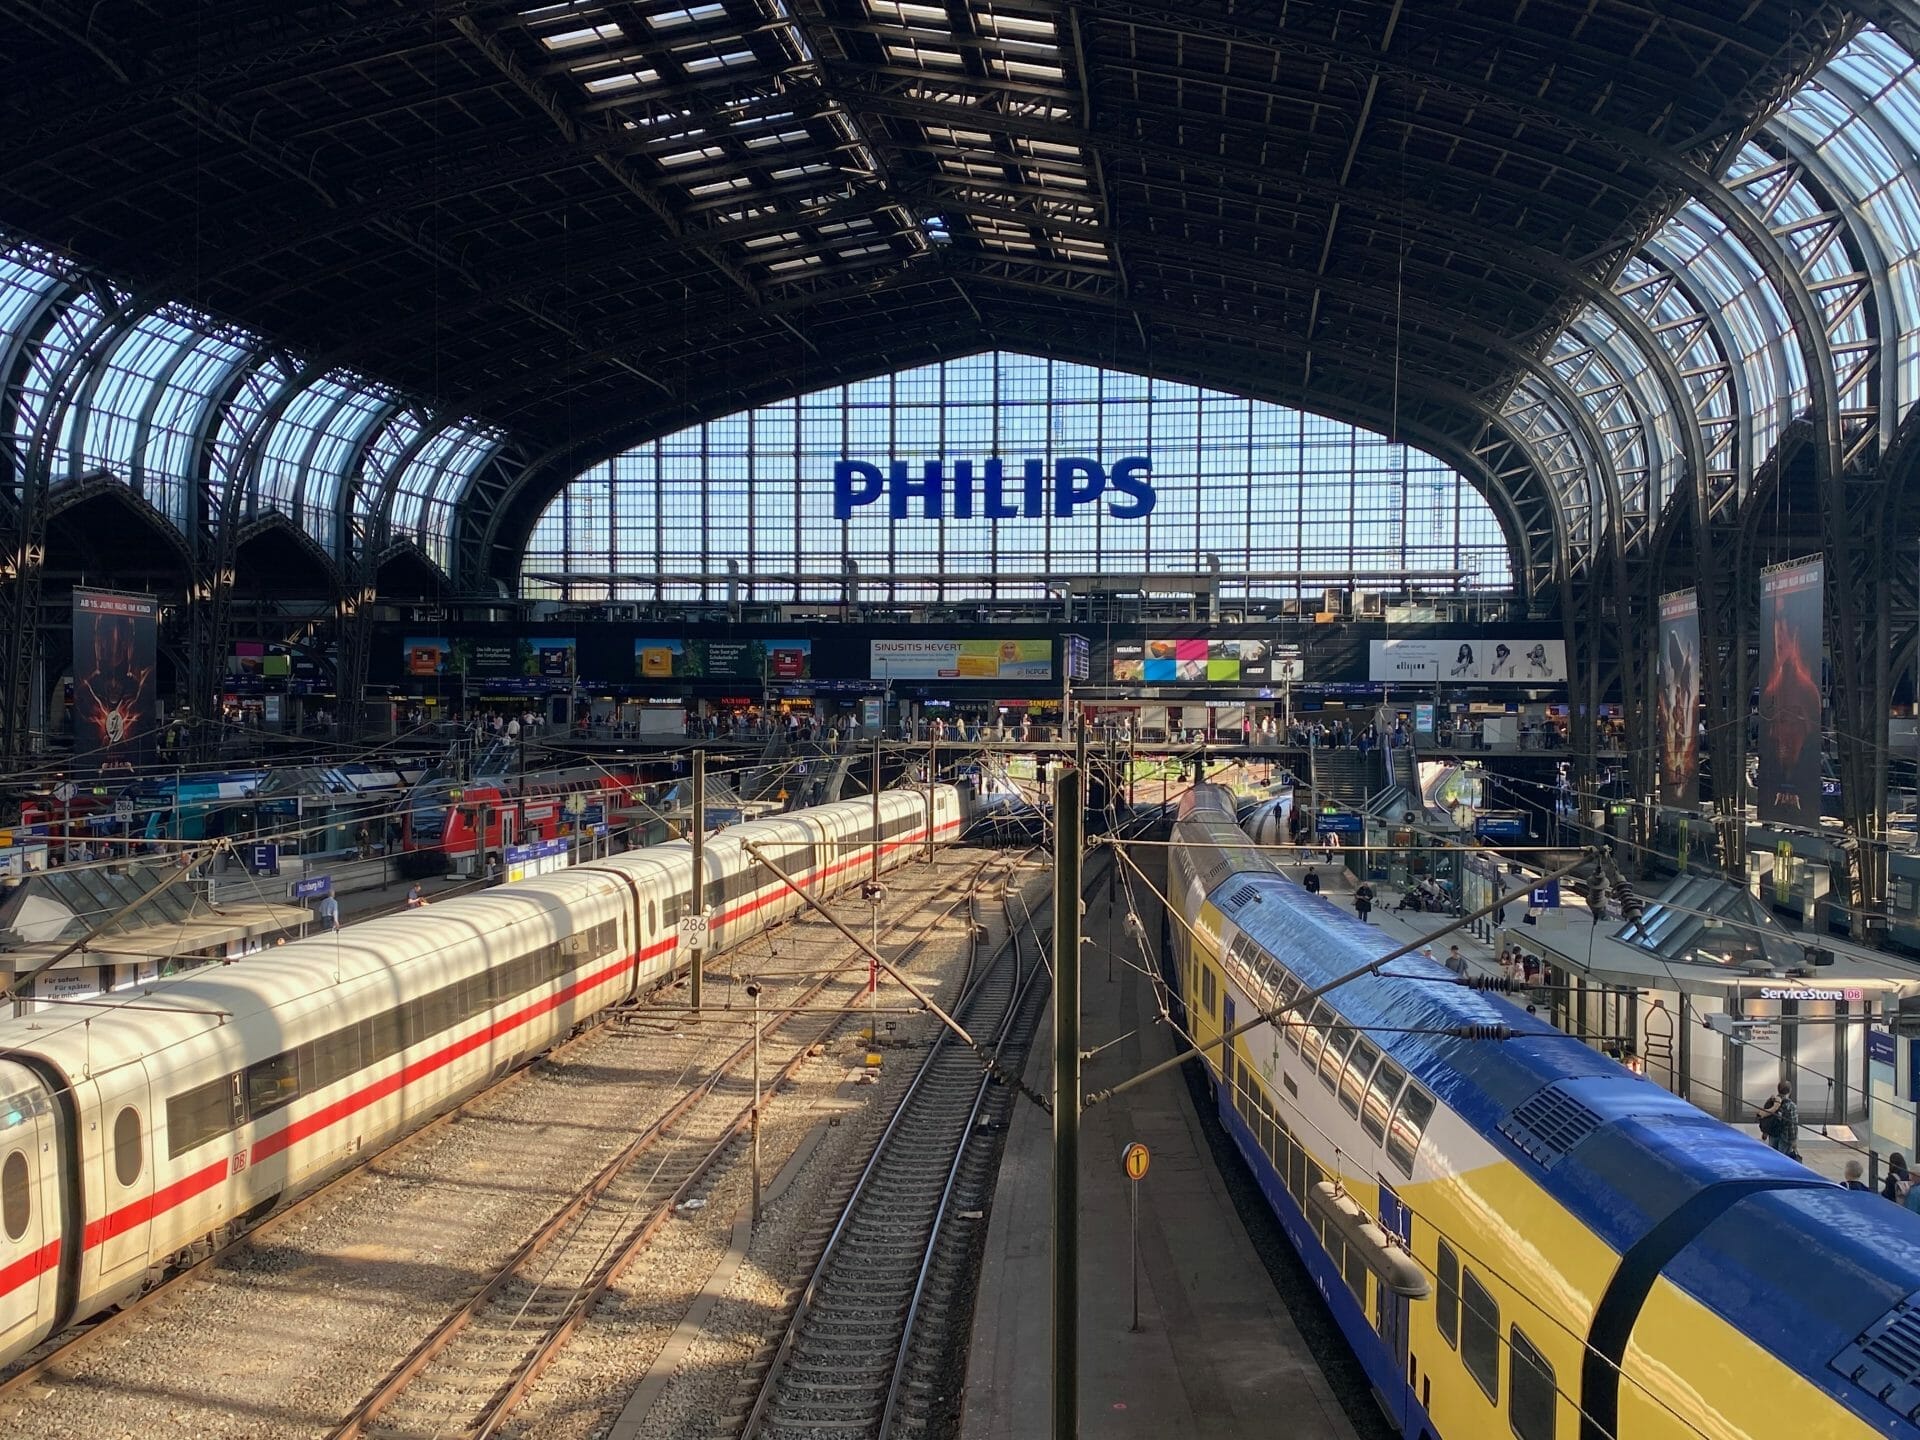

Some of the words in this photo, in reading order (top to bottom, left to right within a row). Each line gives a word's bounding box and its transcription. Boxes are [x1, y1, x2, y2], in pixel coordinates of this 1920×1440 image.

[834, 456, 1156, 519] PHILIPS
[80, 599, 89, 607] AB
[90, 600, 98, 608] 15.
[100, 601, 113, 609] JUNI
[874, 643, 921, 651] SINUSITIS
[924, 643, 963, 651] HEVERT
[799, 764, 805, 773] D
[1283, 775, 1290, 784] D
[117, 802, 132, 811] 286
[254, 846, 267, 866] E
[299, 881, 317, 893] Hamburg
[682, 919, 707, 931] 286
[689, 932, 698, 945] 6
[68, 983, 92, 991] später.
[1760, 987, 1843, 1000] ServiceStore
[1847, 990, 1860, 999] DB
[234, 1075, 240, 1094] 1
[234, 1153, 246, 1171] DB
